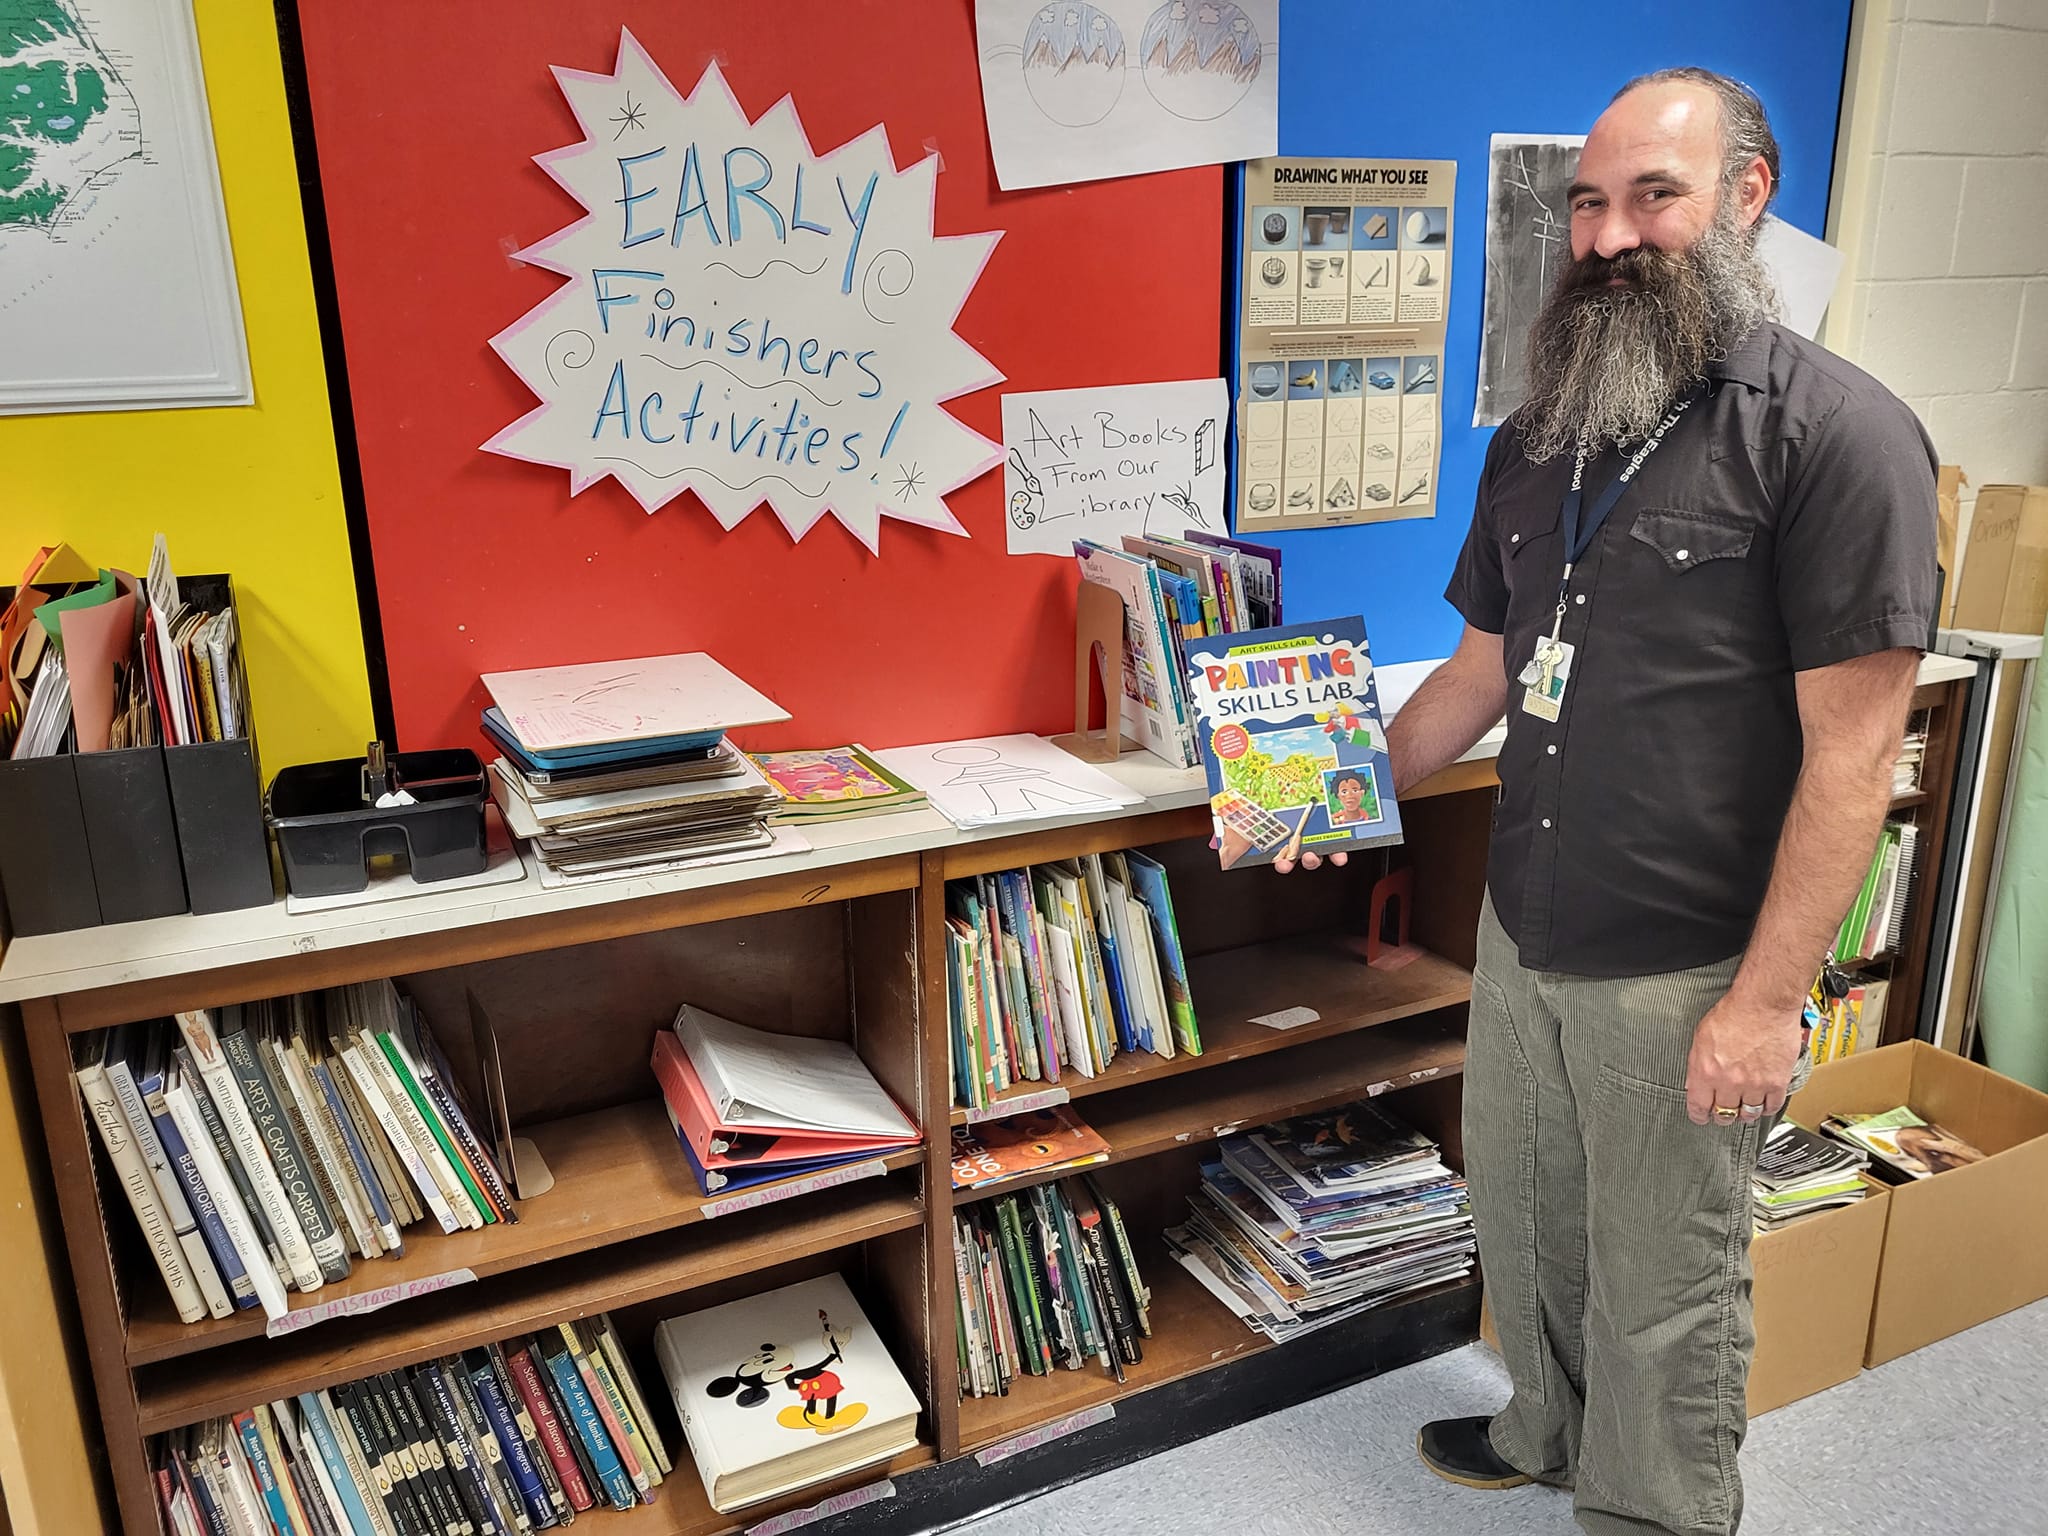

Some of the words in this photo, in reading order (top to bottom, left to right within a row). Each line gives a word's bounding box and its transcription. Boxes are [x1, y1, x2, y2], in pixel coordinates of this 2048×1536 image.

[1274, 168, 1338, 184] DRAWING
[1341, 169, 1380, 184] WHAT
[1380, 170, 1407, 184] YOU
[1409, 170, 1429, 185] SEE
[615, 142, 879, 295] EARLY
[592, 268, 882, 399] Finishers
[592, 358, 911, 484] Activities!
[1024, 408, 1083, 458] Art
[1094, 411, 1187, 448] Books
[1655, 414, 1680, 437] The
[1041, 462, 1107, 488] From
[1117, 459, 1160, 476] Our
[1571, 448, 1587, 491] School
[1620, 440, 1659, 483] Eagles
[1038, 491, 1156, 537] Library
[1239, 644, 1258, 655] ART
[1259, 640, 1290, 653] SKILLS
[1290, 638, 1308, 649] LAB
[1205, 648, 1356, 693] PAINTING
[1218, 688, 1299, 717] SKILLS
[1307, 681, 1353, 704] LAB
[227, 1040, 243, 1067] HASLAM
[236, 1036, 254, 1070] MALCOLM
[113, 1074, 138, 1112] GREATEST
[132, 1110, 148, 1138] TEAM
[141, 1134, 159, 1159] EVER
[396, 1091, 412, 1115] DIEGO
[411, 1113, 437, 1154] VELASQUEZ
[214, 1075, 246, 1136] SMITHSONIAN
[240, 1133, 266, 1182] TIMELINES
[264, 1188, 290, 1226] ANCIENT
[244, 1078, 268, 1112] ARTS
[260, 1113, 270, 1126] &
[268, 1126, 300, 1181] CRAFTS
[291, 1181, 326, 1240] CARPETS
[966, 1146, 1001, 1174] ONE
[179, 1153, 217, 1219] BEADWORK
[127, 1168, 148, 1200] THE
[141, 1202, 185, 1288] LITHOGRAPHS
[214, 1191, 231, 1219] Colors
[230, 1224, 248, 1256] Paradise
[1005, 1227, 1015, 1250] FOREST
[1090, 1229, 1100, 1247] Our
[1095, 1246, 1109, 1267] world
[1103, 1276, 1114, 1295] space
[1109, 1295, 1118, 1310] and
[277, 1308, 315, 1331] ART
[327, 1286, 401, 1317] HISTORY
[1113, 1308, 1122, 1324] time
[459, 1376, 473, 1402] ANCIENT
[470, 1401, 483, 1424] WORLD
[494, 1355, 507, 1381] ANCIENT
[504, 1380, 517, 1403] WORLD
[363, 1396, 385, 1440] ARCHITECTURE
[374, 1394, 398, 1438] ARCHITECTURE
[390, 1390, 400, 1408] FINE
[397, 1407, 409, 1424] ART
[403, 1385, 425, 1429] ARCHITECTURE
[431, 1376, 441, 1389] ART
[436, 1388, 455, 1421] AUCTION
[452, 1421, 471, 1457] MYSTERY
[487, 1381, 501, 1407] Man's
[497, 1406, 510, 1424] Past
[506, 1422, 518, 1440] and
[513, 1441, 532, 1474] Progress
[523, 1366, 542, 1397] Science
[537, 1400, 552, 1417] and
[545, 1420, 568, 1459] Discovery
[566, 1373, 578, 1391] The
[573, 1390, 586, 1408] Arts
[581, 1407, 590, 1418] of
[586, 1418, 608, 1451] Mankind
[350, 1407, 372, 1453] SCULPTURE
[249, 1436, 261, 1462] North
[257, 1460, 274, 1492] Carolina
[471, 1467, 480, 1479] ANNA
[346, 1454, 362, 1488] FREDERIC
[360, 1486, 384, 1531] REMINGTON
